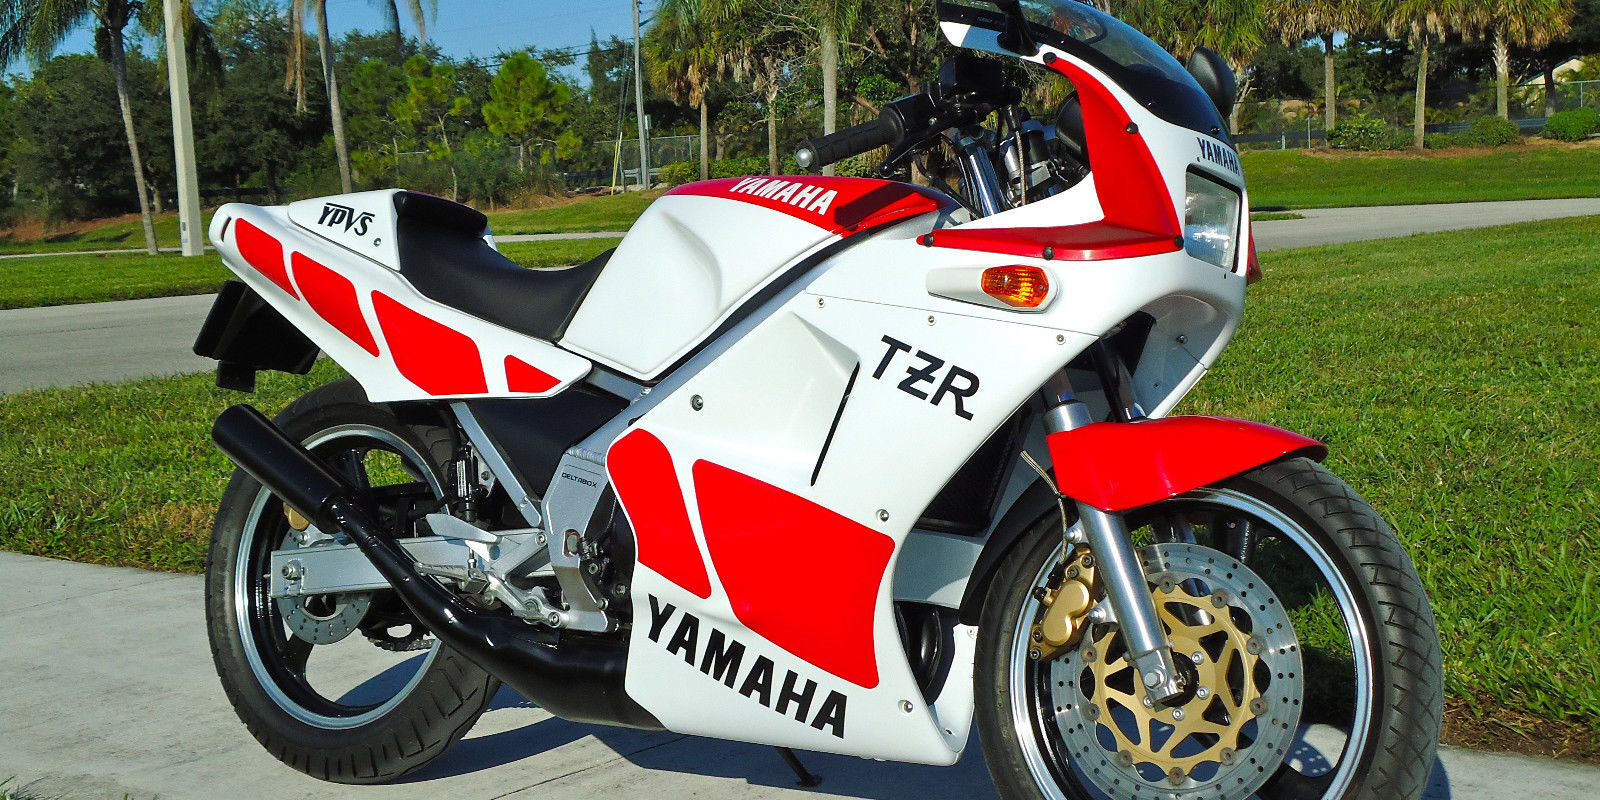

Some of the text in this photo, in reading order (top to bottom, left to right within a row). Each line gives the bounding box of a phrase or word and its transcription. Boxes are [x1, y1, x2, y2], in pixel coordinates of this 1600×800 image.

[1196, 137, 1240, 176] YAMAHA
[729, 178, 838, 215] YAMAHA
[872, 334, 980, 421] TZR
[561, 472, 597, 488] DELTABOX
[648, 593, 848, 739] YAMAHA
